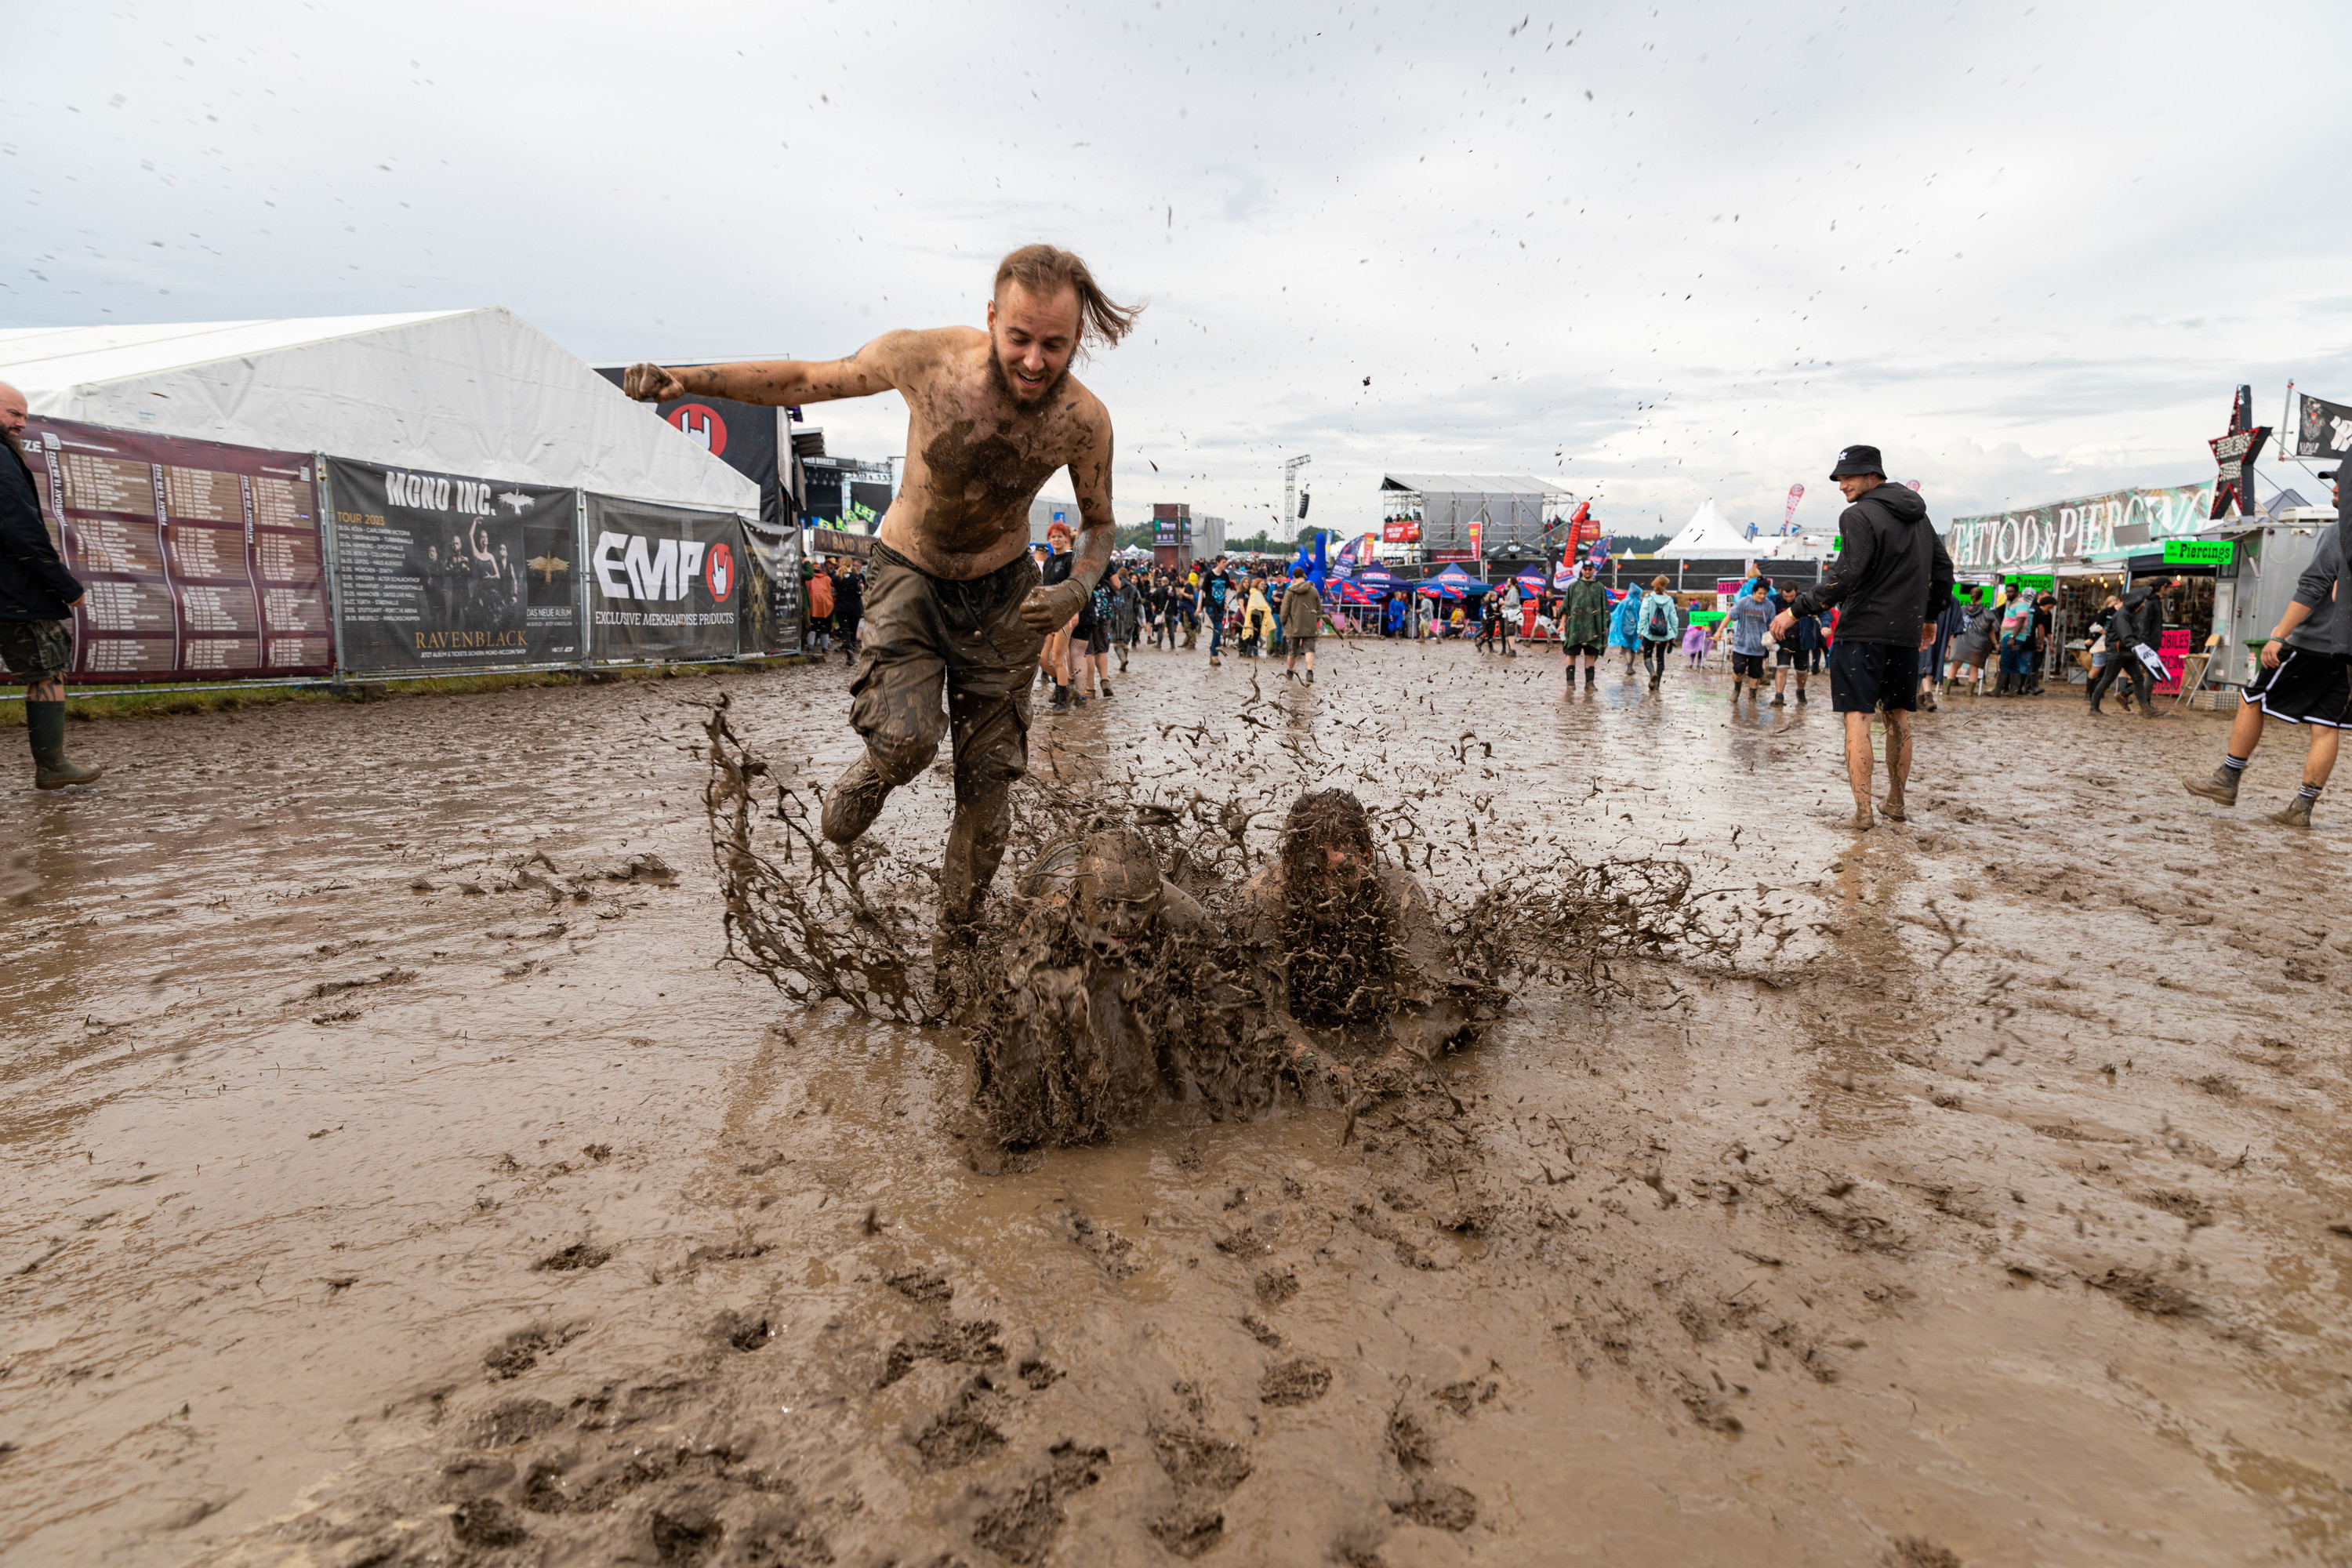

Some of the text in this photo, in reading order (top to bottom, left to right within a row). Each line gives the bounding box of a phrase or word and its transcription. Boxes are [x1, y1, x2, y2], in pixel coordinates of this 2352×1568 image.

[385, 470, 496, 516] MONO INC.
[53, 490, 69, 527] THURSDAY
[159, 501, 169, 526] FRIDAY
[246, 510, 255, 543] SATURDAY
[337, 511, 386, 526] TOUR 2023
[832, 535, 855, 553] BAND
[1953, 515, 2039, 565] TATTOO
[2180, 543, 2230, 562] Piercings
[593, 530, 706, 601] EMP
[2016, 576, 2052, 590] Piercings
[527, 608, 572, 617] DAS NEUE ALBUM
[595, 611, 641, 626] EXCLUSIVE
[642, 612, 699, 626] MERCHANDISE
[415, 630, 528, 649] RAVENBLACK
[2161, 634, 2189, 648] OBILES
